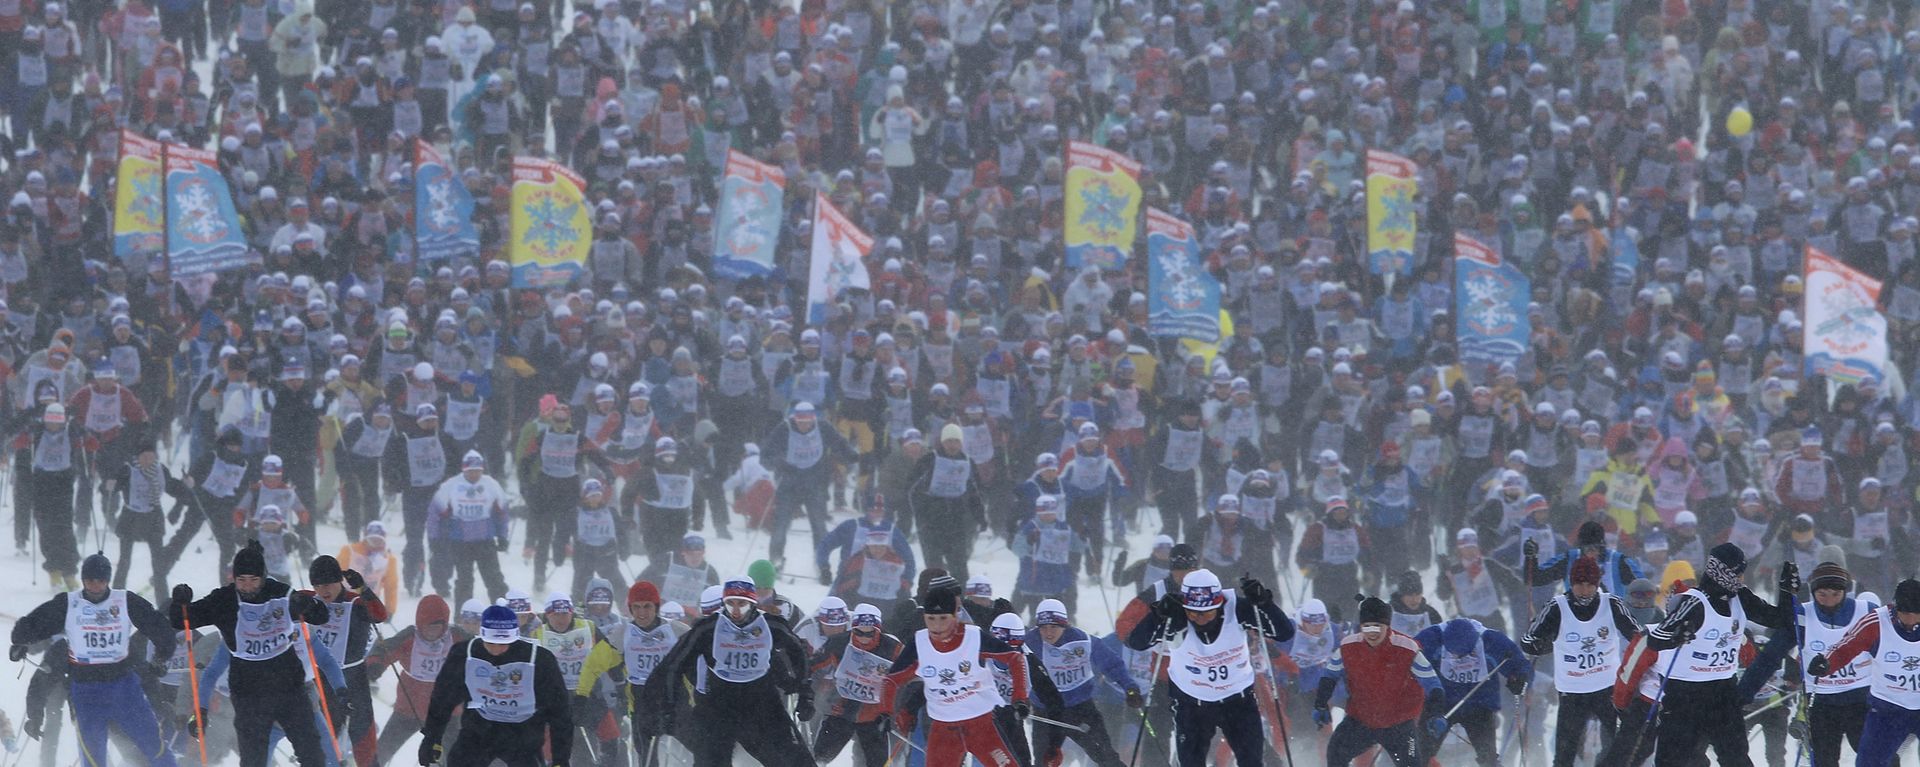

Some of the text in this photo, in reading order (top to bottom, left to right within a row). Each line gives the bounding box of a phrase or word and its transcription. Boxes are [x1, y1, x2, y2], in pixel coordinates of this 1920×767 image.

[83, 632, 122, 648] 16544
[723, 651, 759, 669] 4136
[1207, 665, 1229, 682] 59
